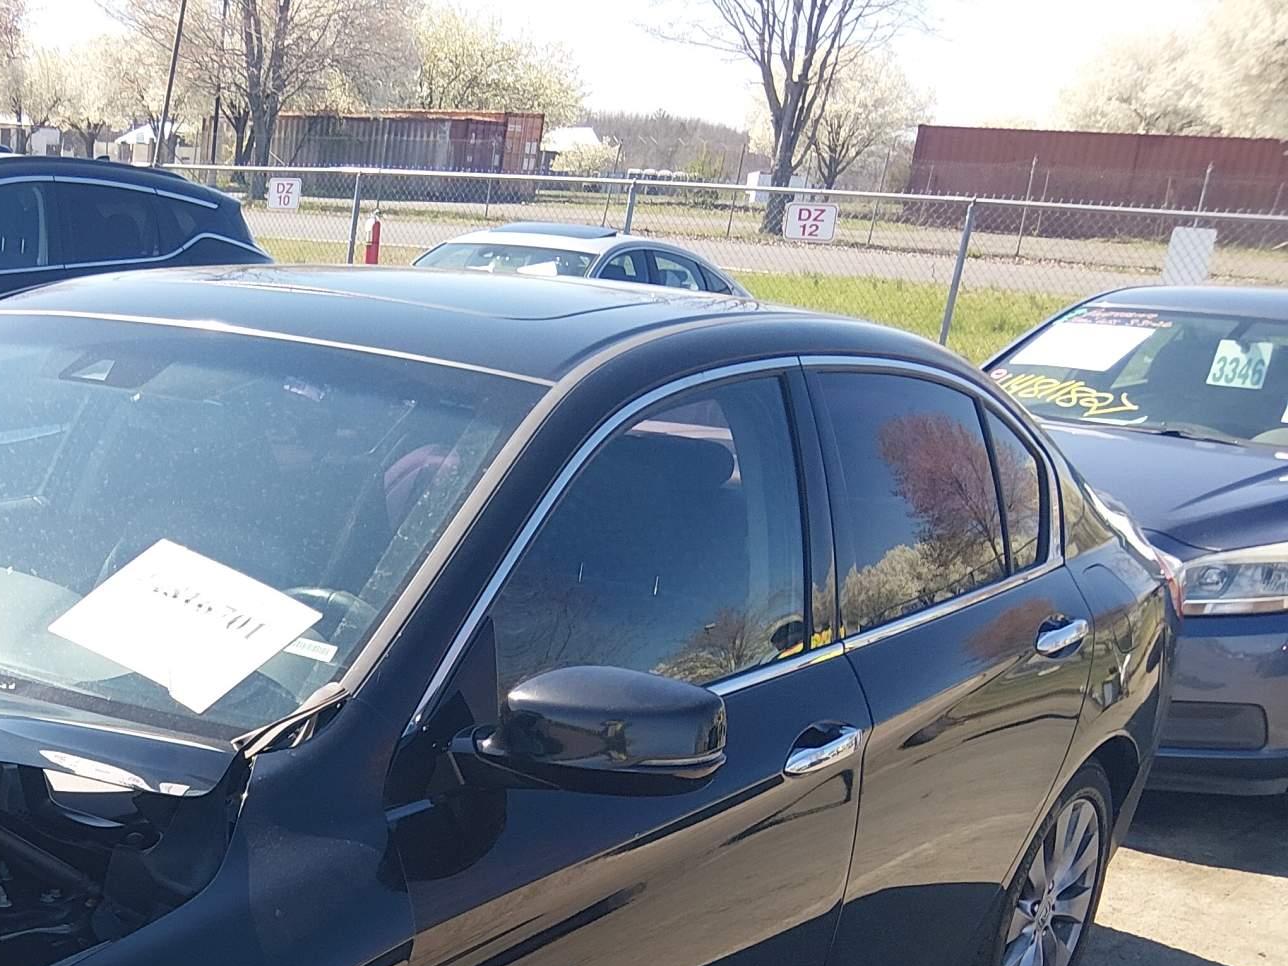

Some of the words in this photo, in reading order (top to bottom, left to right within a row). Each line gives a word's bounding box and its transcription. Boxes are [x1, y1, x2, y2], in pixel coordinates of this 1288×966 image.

[276, 182, 294, 194] DZ
[278, 195, 290, 206] 10
[797, 208, 826, 222] DZ
[799, 223, 820, 237] 12
[1212, 356, 1266, 386] 3346
